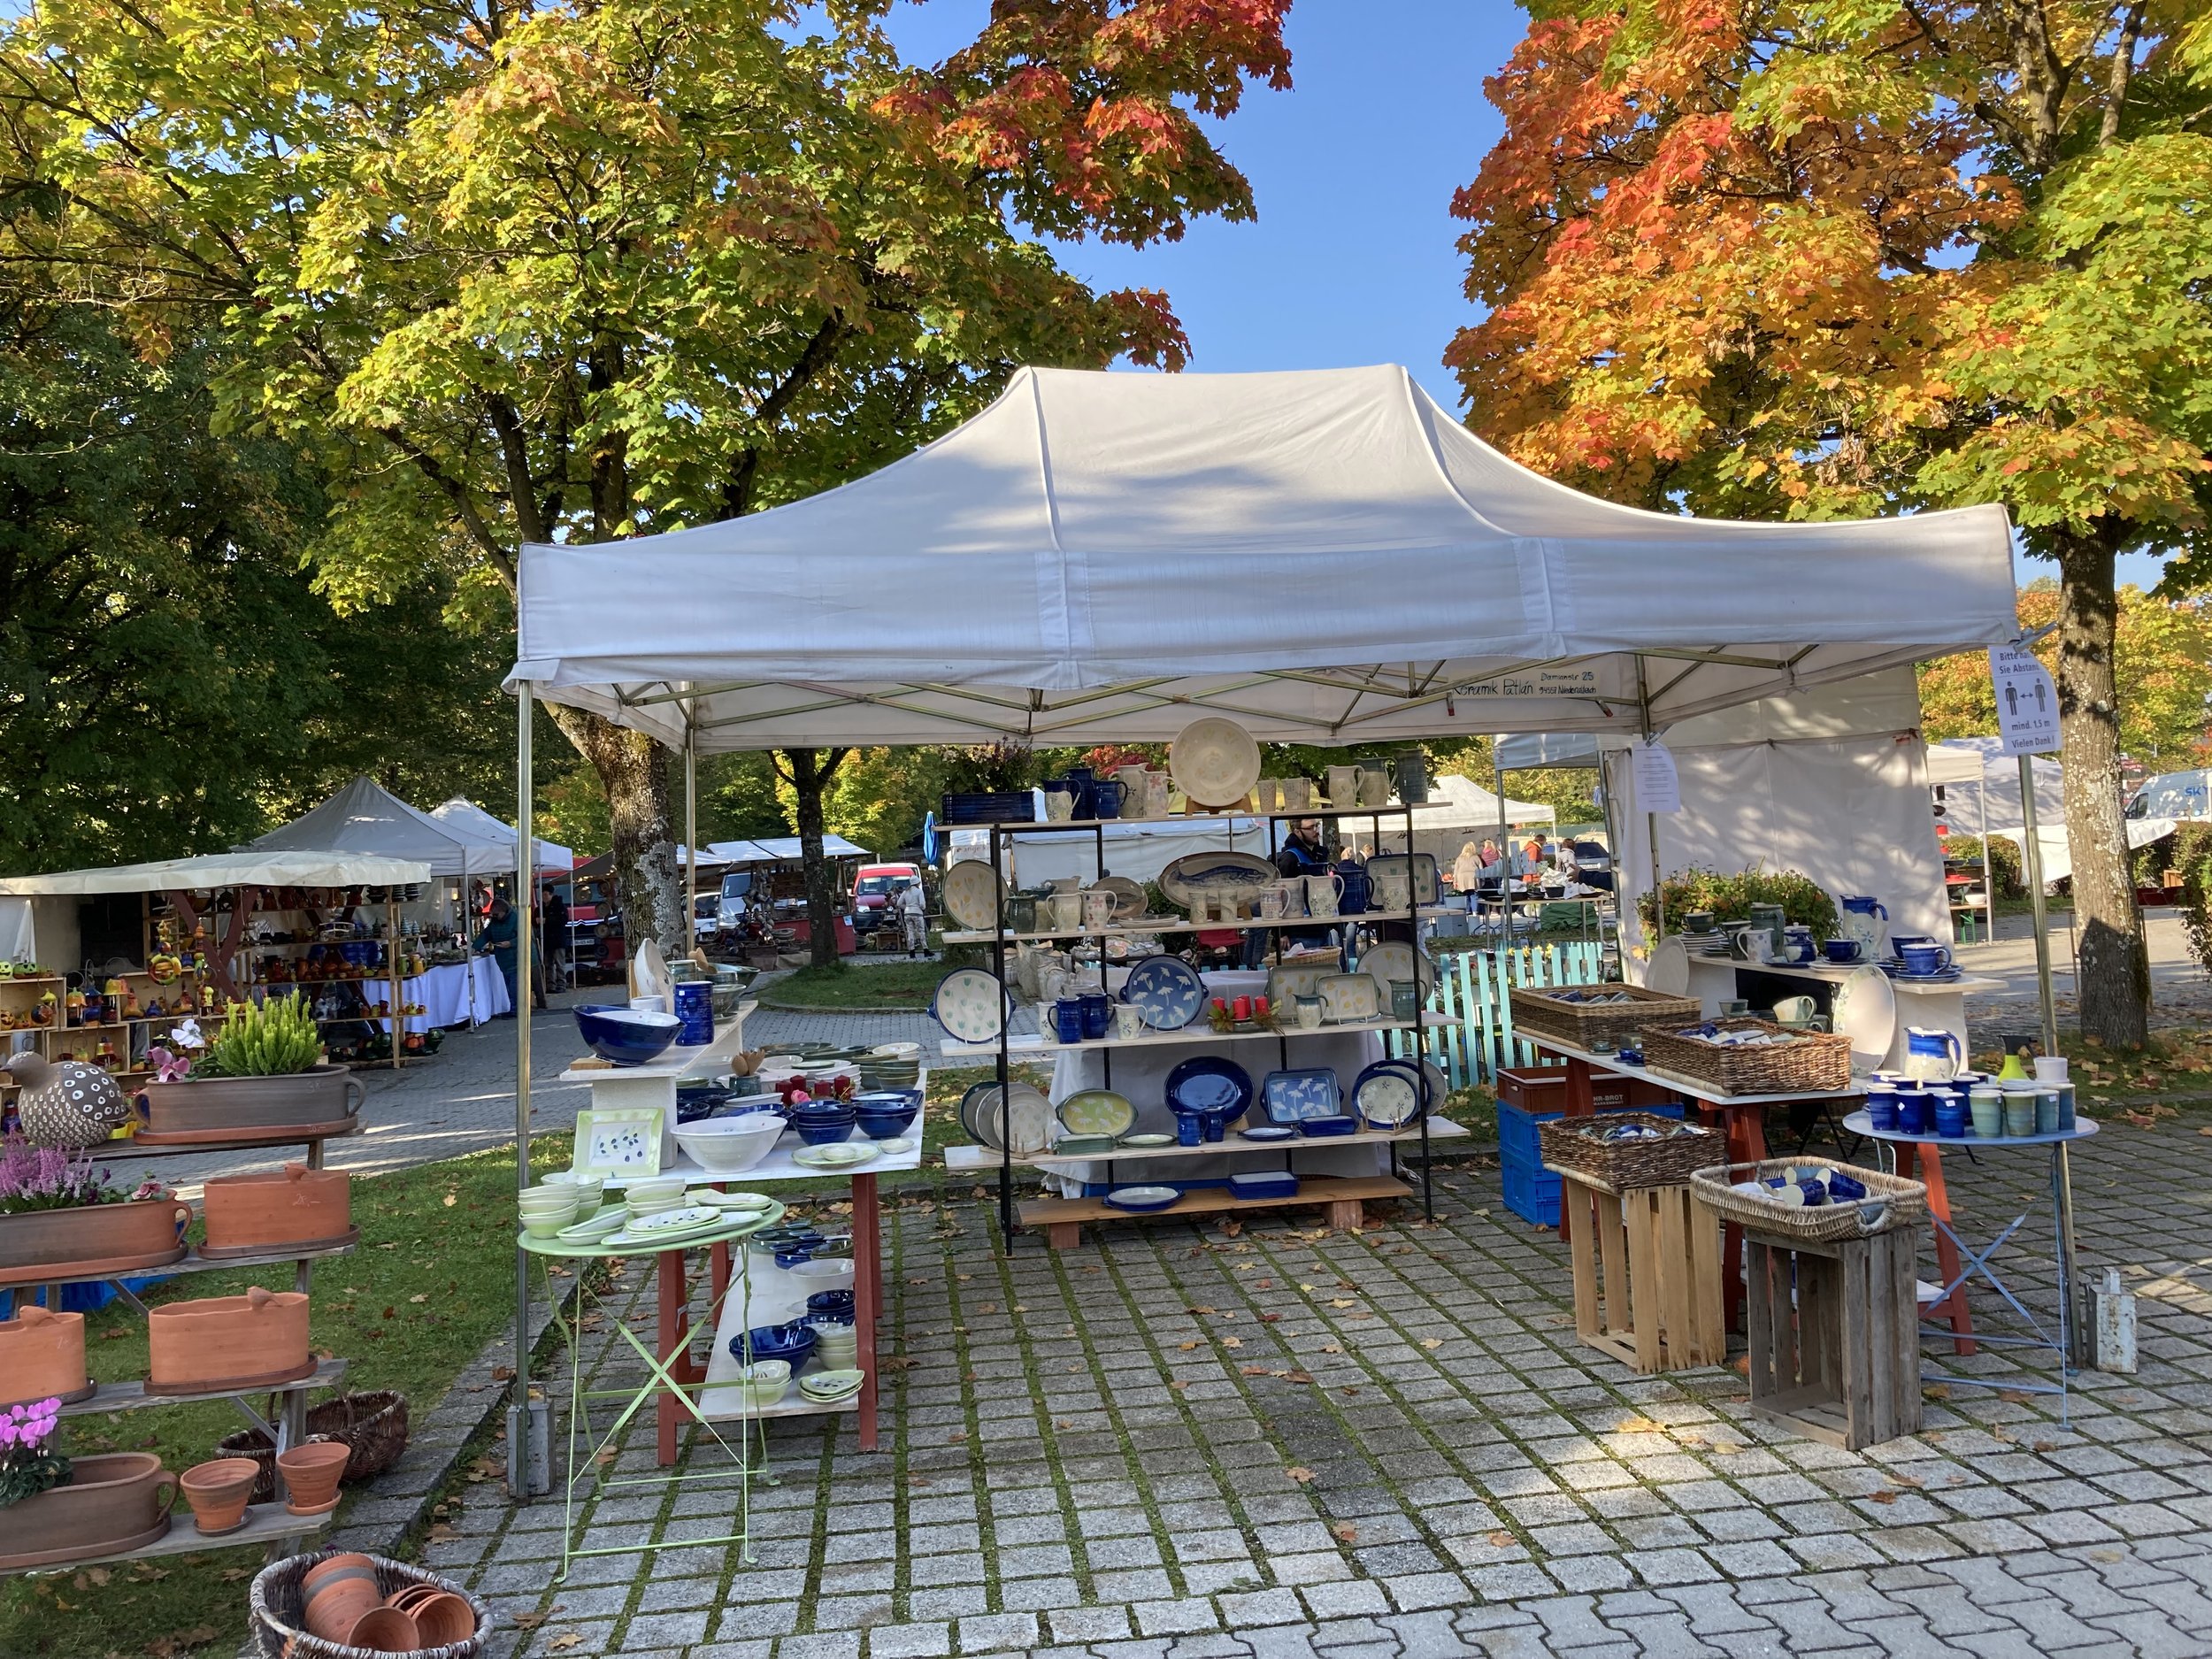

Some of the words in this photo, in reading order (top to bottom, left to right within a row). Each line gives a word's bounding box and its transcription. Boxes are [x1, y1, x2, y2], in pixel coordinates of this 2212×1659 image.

[2000, 652, 2018, 661] Bitte
[2000, 665, 2011, 674] Sie
[1581, 671, 1594, 681] 25
[2011, 721, 2032, 731] mind.
[2033, 720, 2043, 729] 1,5
[2011, 737, 2034, 749] Vielen
